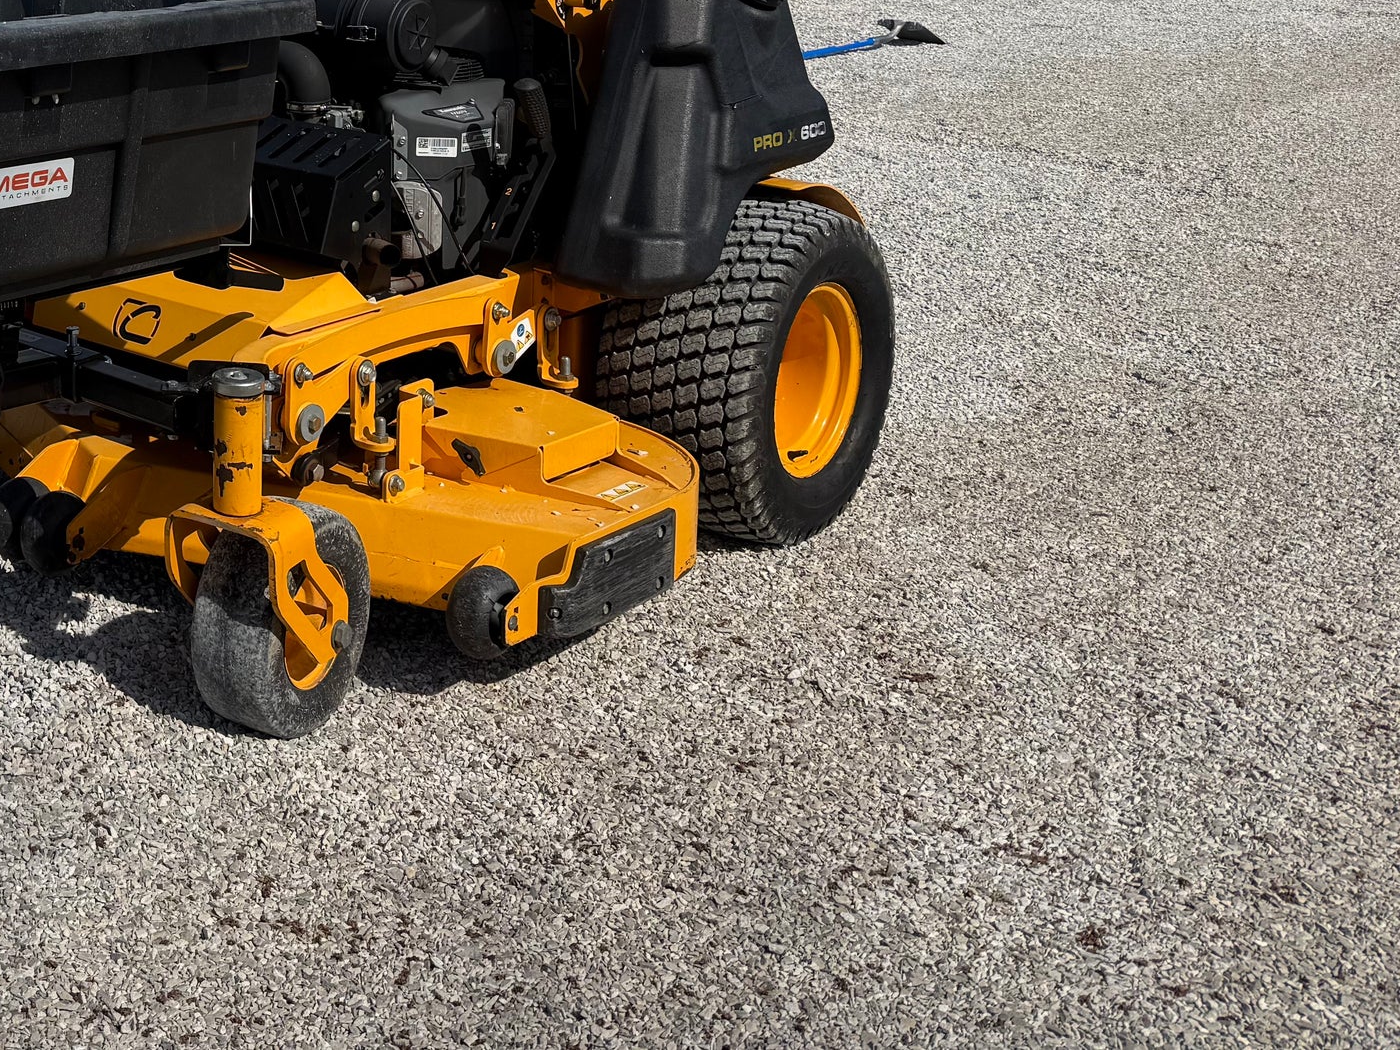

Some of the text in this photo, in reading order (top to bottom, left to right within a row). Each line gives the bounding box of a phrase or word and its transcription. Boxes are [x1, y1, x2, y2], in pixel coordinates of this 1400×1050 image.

[753, 131, 784, 152] PRO
[800, 121, 826, 140] 600
[505, 188, 512, 196] 2
[491, 222, 496, 230] 1
